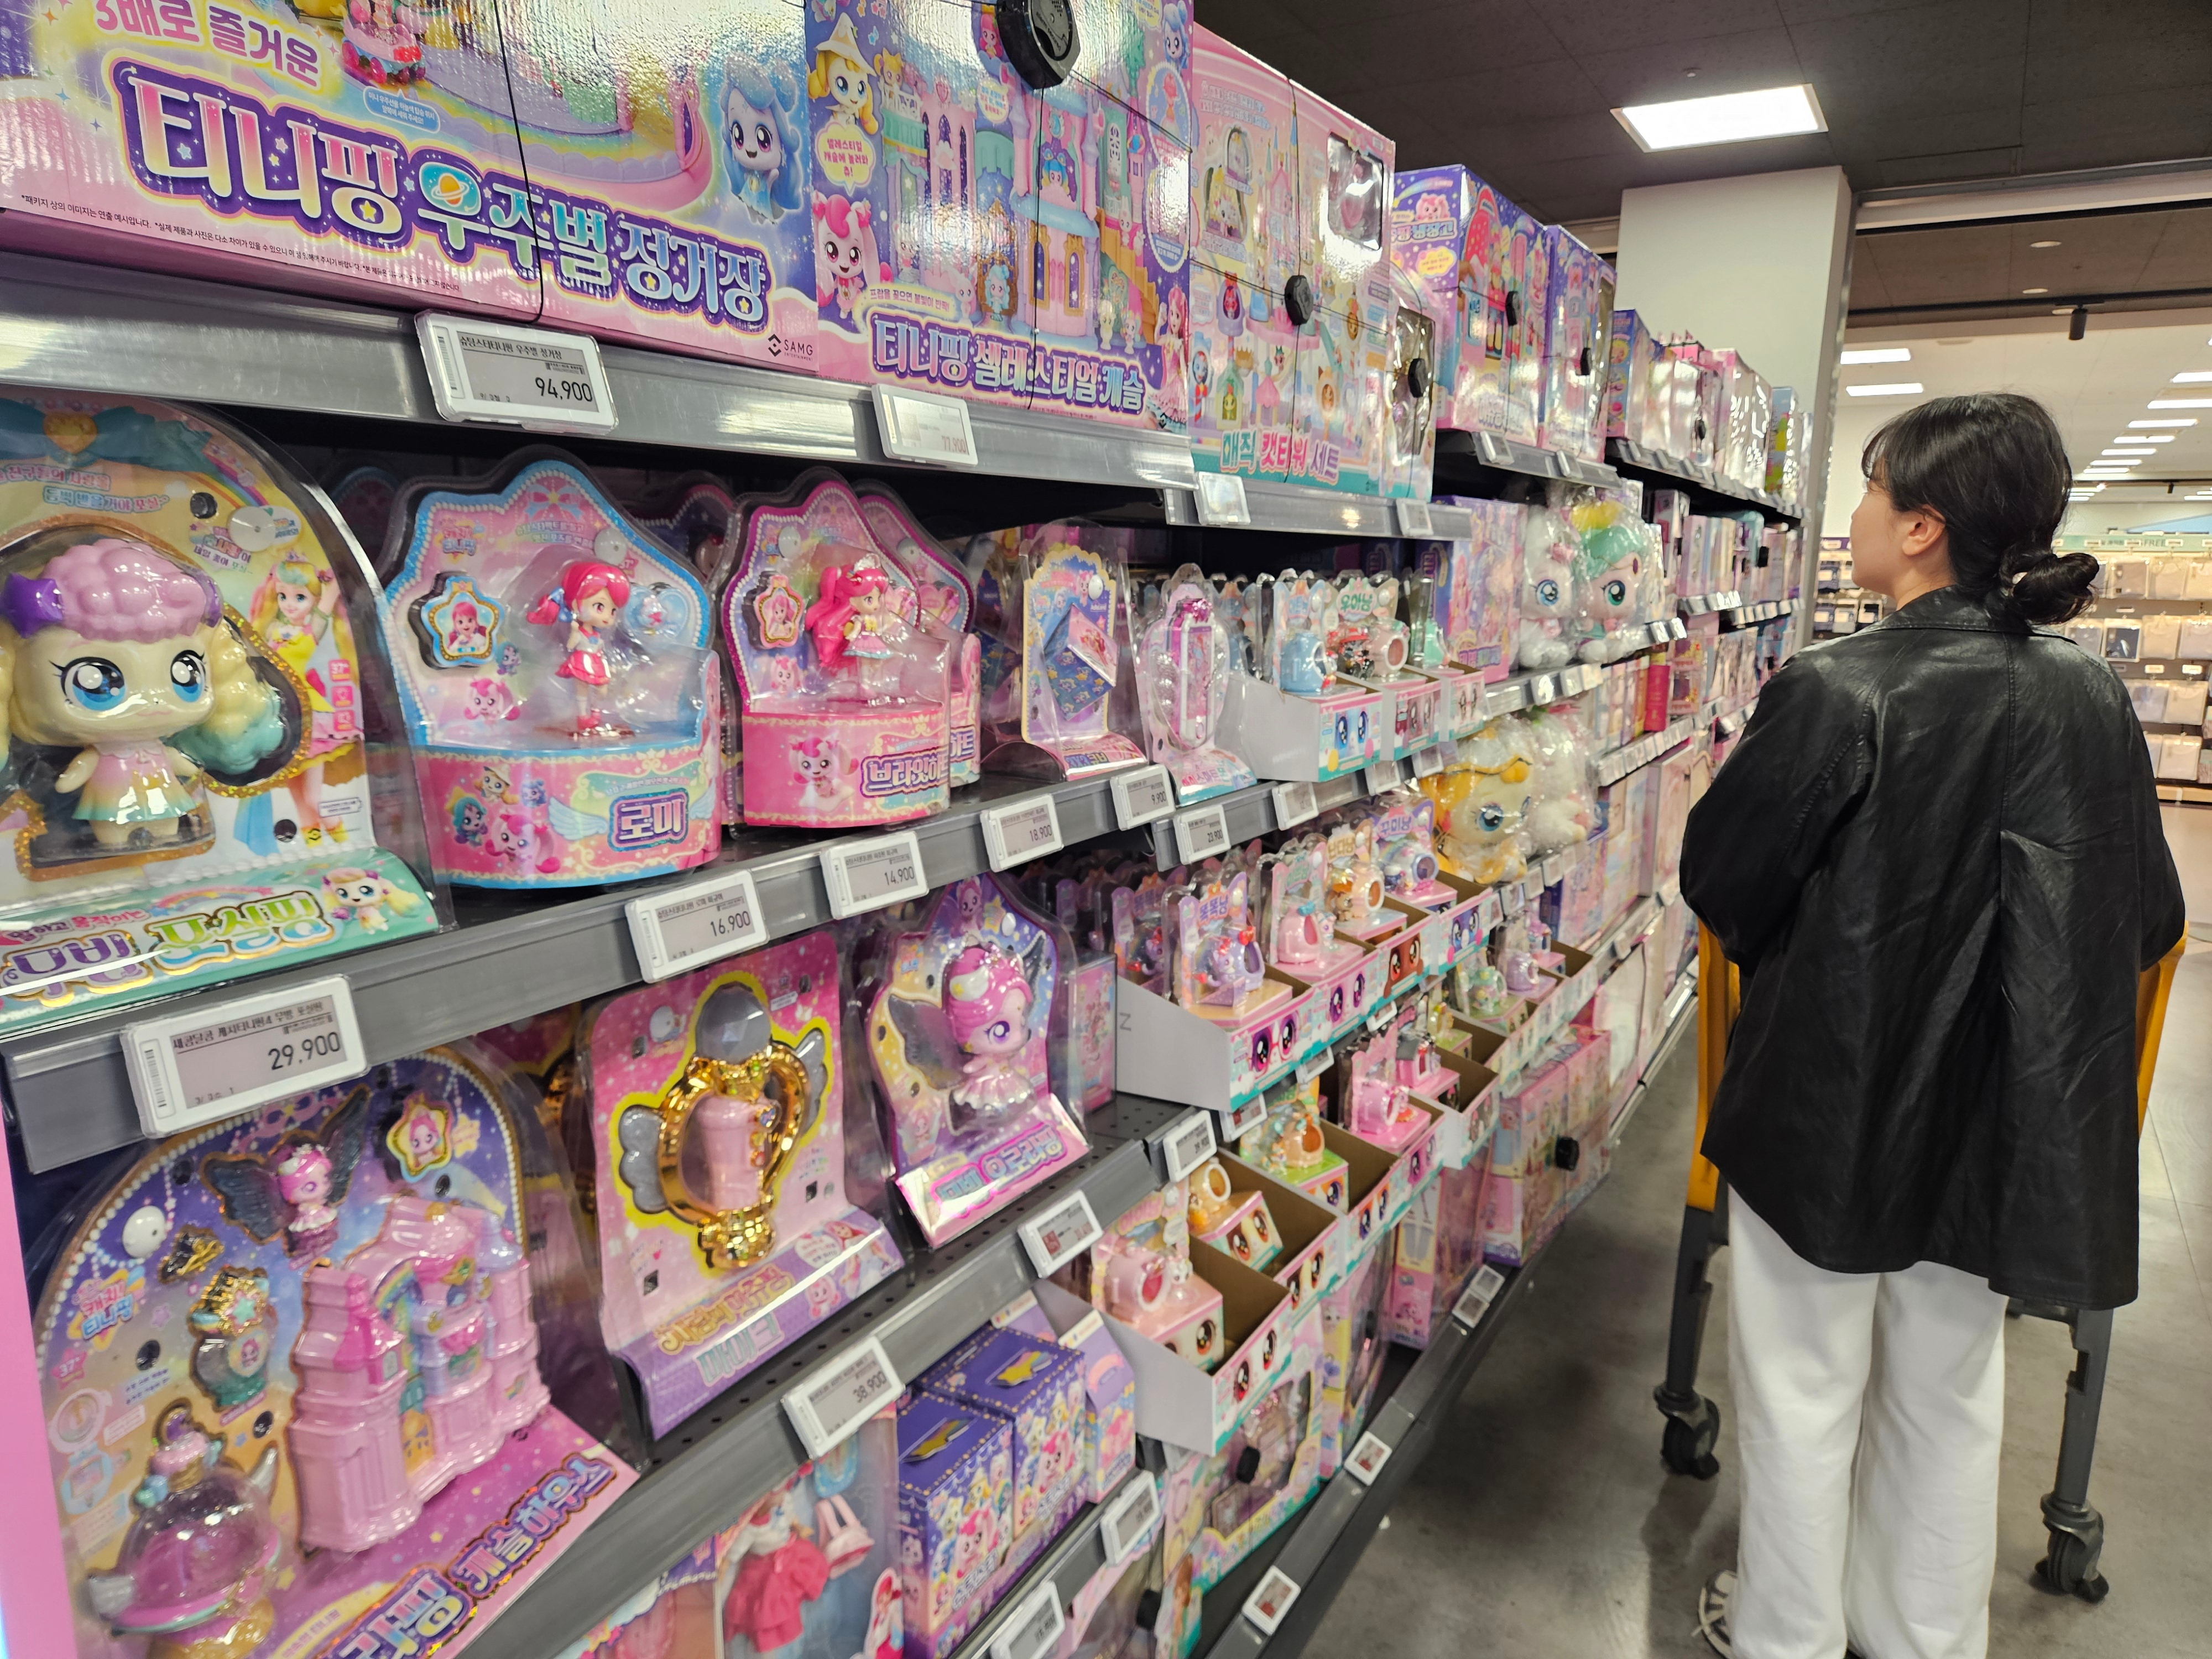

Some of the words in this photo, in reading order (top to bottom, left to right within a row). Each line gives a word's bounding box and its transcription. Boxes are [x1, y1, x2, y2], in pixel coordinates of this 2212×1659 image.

[209, 8, 319, 87] 즐거운
[128, 76, 404, 234] 티니핑
[50, 201, 66, 211] 상의
[67, 204, 97, 217] 이미지는
[98, 210, 113, 221] 연출
[114, 213, 152, 228] 예시입니다.
[173, 226, 193, 237] 제품과
[194, 230, 213, 241] 사진은
[215, 234, 228, 243] 다소
[229, 237, 248, 248] 차이가
[418, 163, 612, 286] 우주별
[619, 221, 766, 323] 정거장
[784, 338, 813, 356] SAMG
[875, 319, 969, 383] 티니핑
[974, 336, 1100, 401] 셀레스티얼
[1100, 362, 1144, 410] 캐슬
[1222, 430, 1256, 469] 매직
[1311, 440, 1339, 480] 세트
[618, 798, 685, 835] 로미
[153, 896, 328, 966] 포실핑
